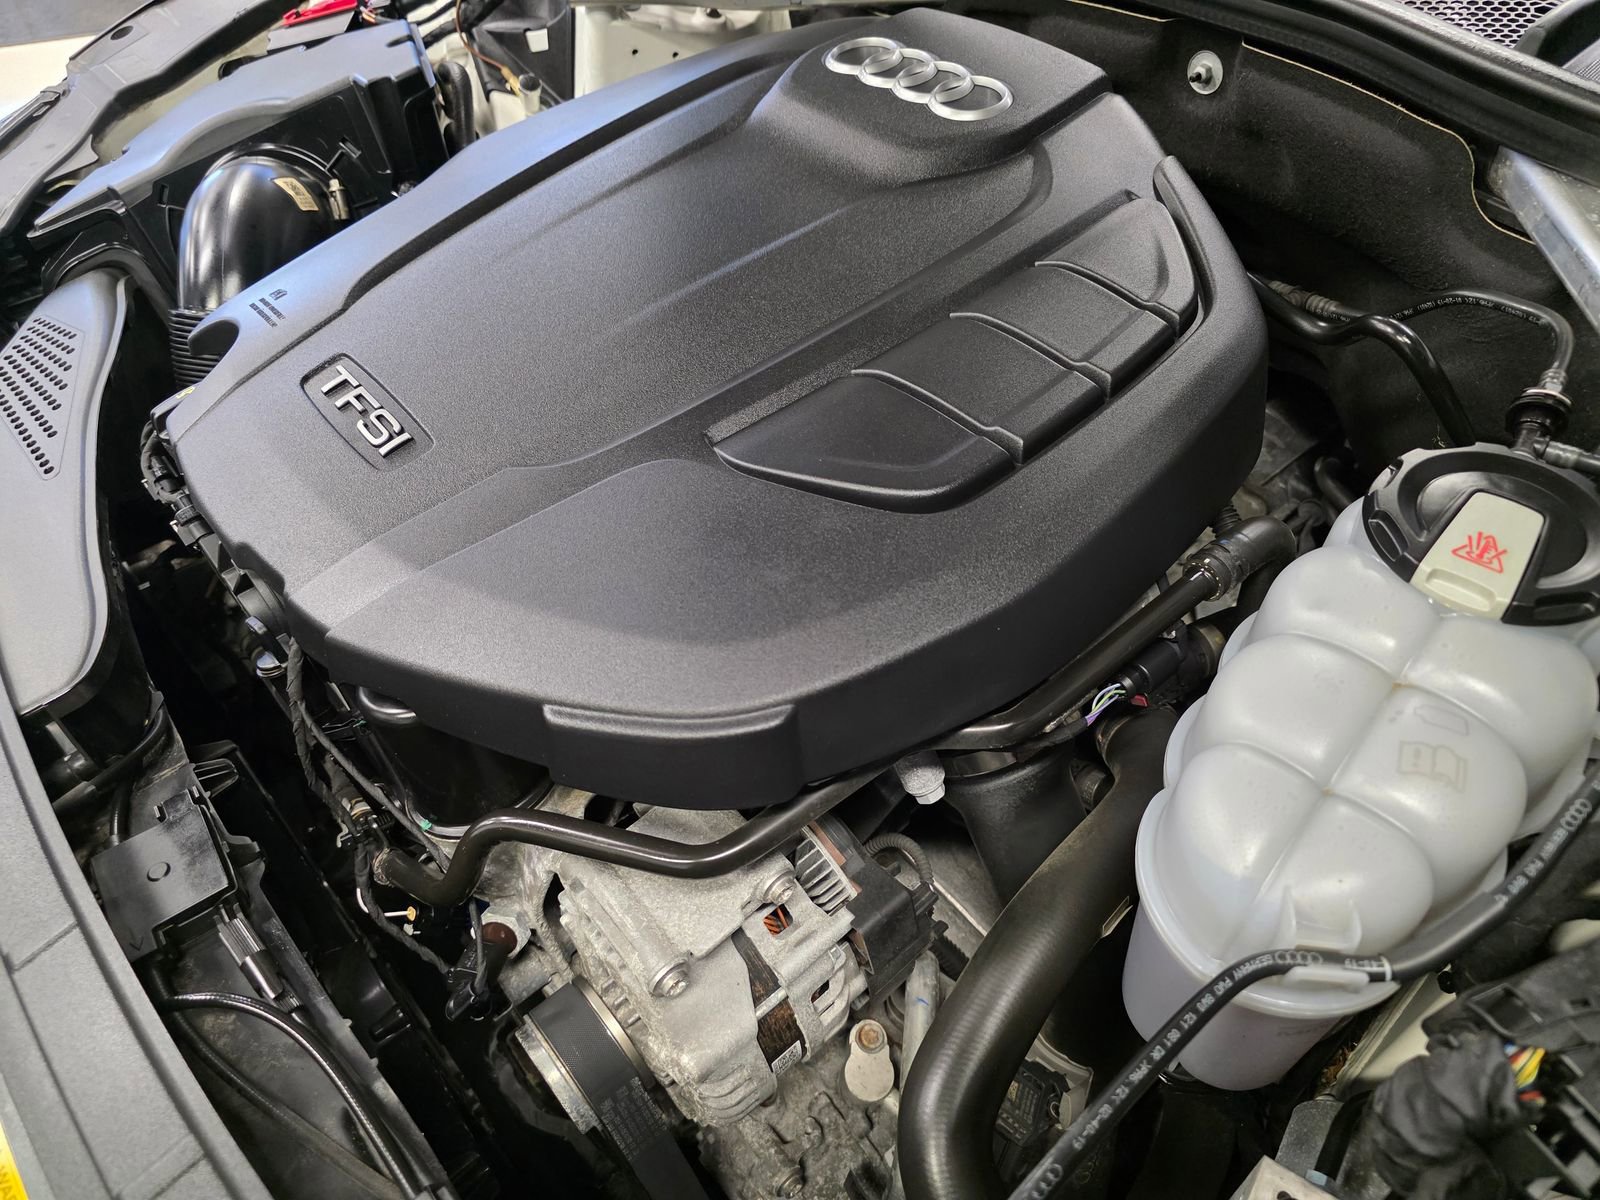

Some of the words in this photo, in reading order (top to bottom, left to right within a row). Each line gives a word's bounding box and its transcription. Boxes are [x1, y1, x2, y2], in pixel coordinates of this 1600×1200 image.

[321, 364, 413, 457] TFSI
[1232, 953, 1273, 981] GERMANY
[1179, 1011, 1197, 1029] 121
